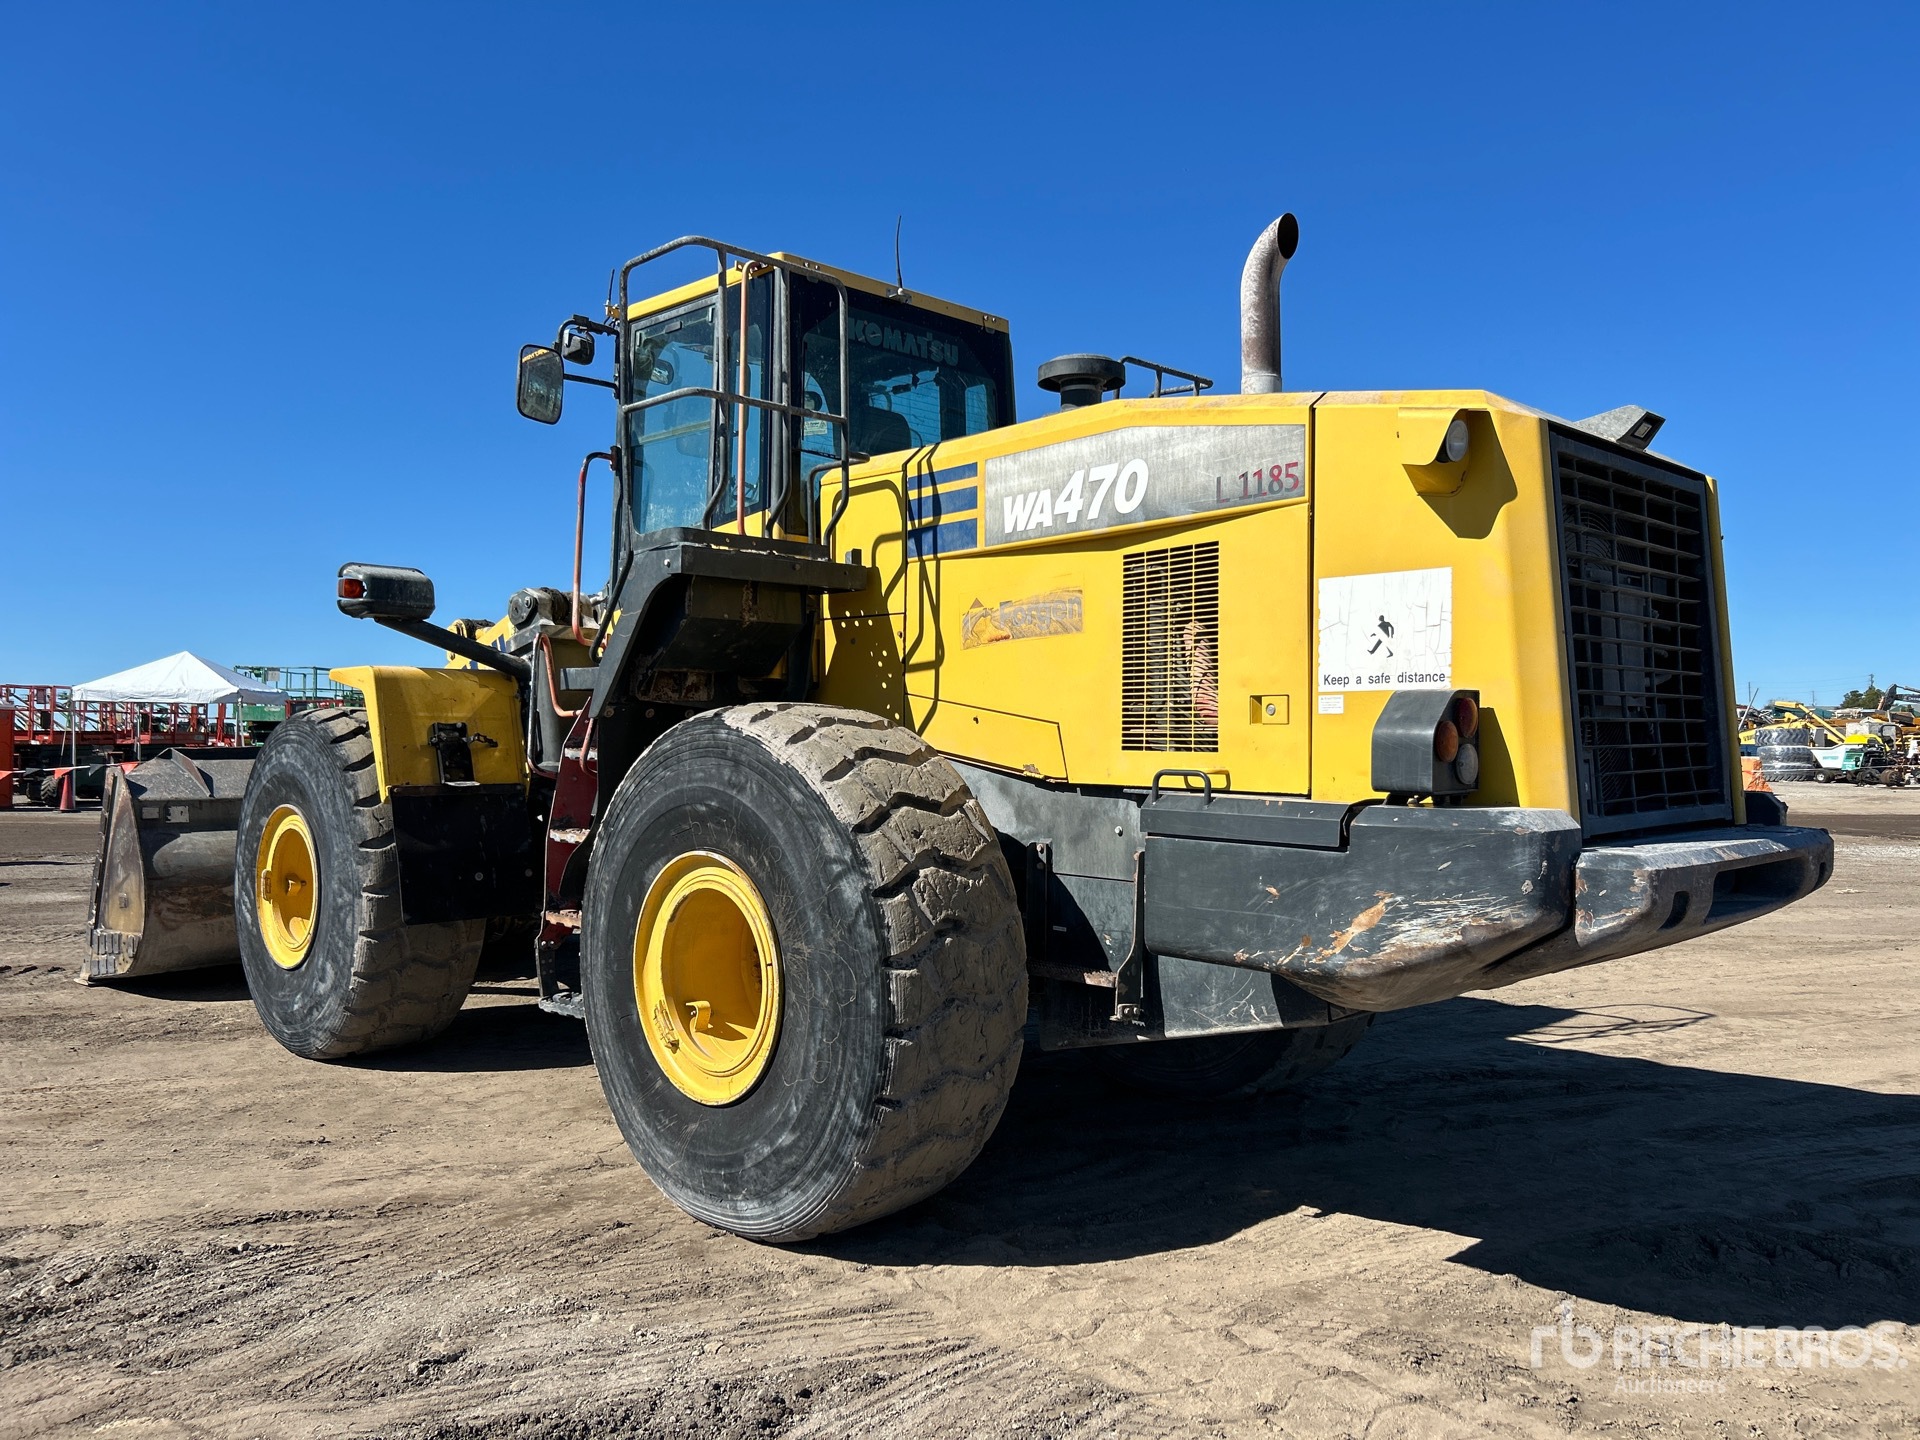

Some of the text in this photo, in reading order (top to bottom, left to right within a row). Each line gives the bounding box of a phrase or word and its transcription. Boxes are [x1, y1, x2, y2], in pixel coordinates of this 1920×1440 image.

[848, 317, 958, 366] KOMATSU
[1003, 458, 1149, 533] WA470
[1216, 461, 1300, 503] L 1185
[1000, 596, 1082, 632] Forgen
[1323, 671, 1445, 687] Keep a safe distance
